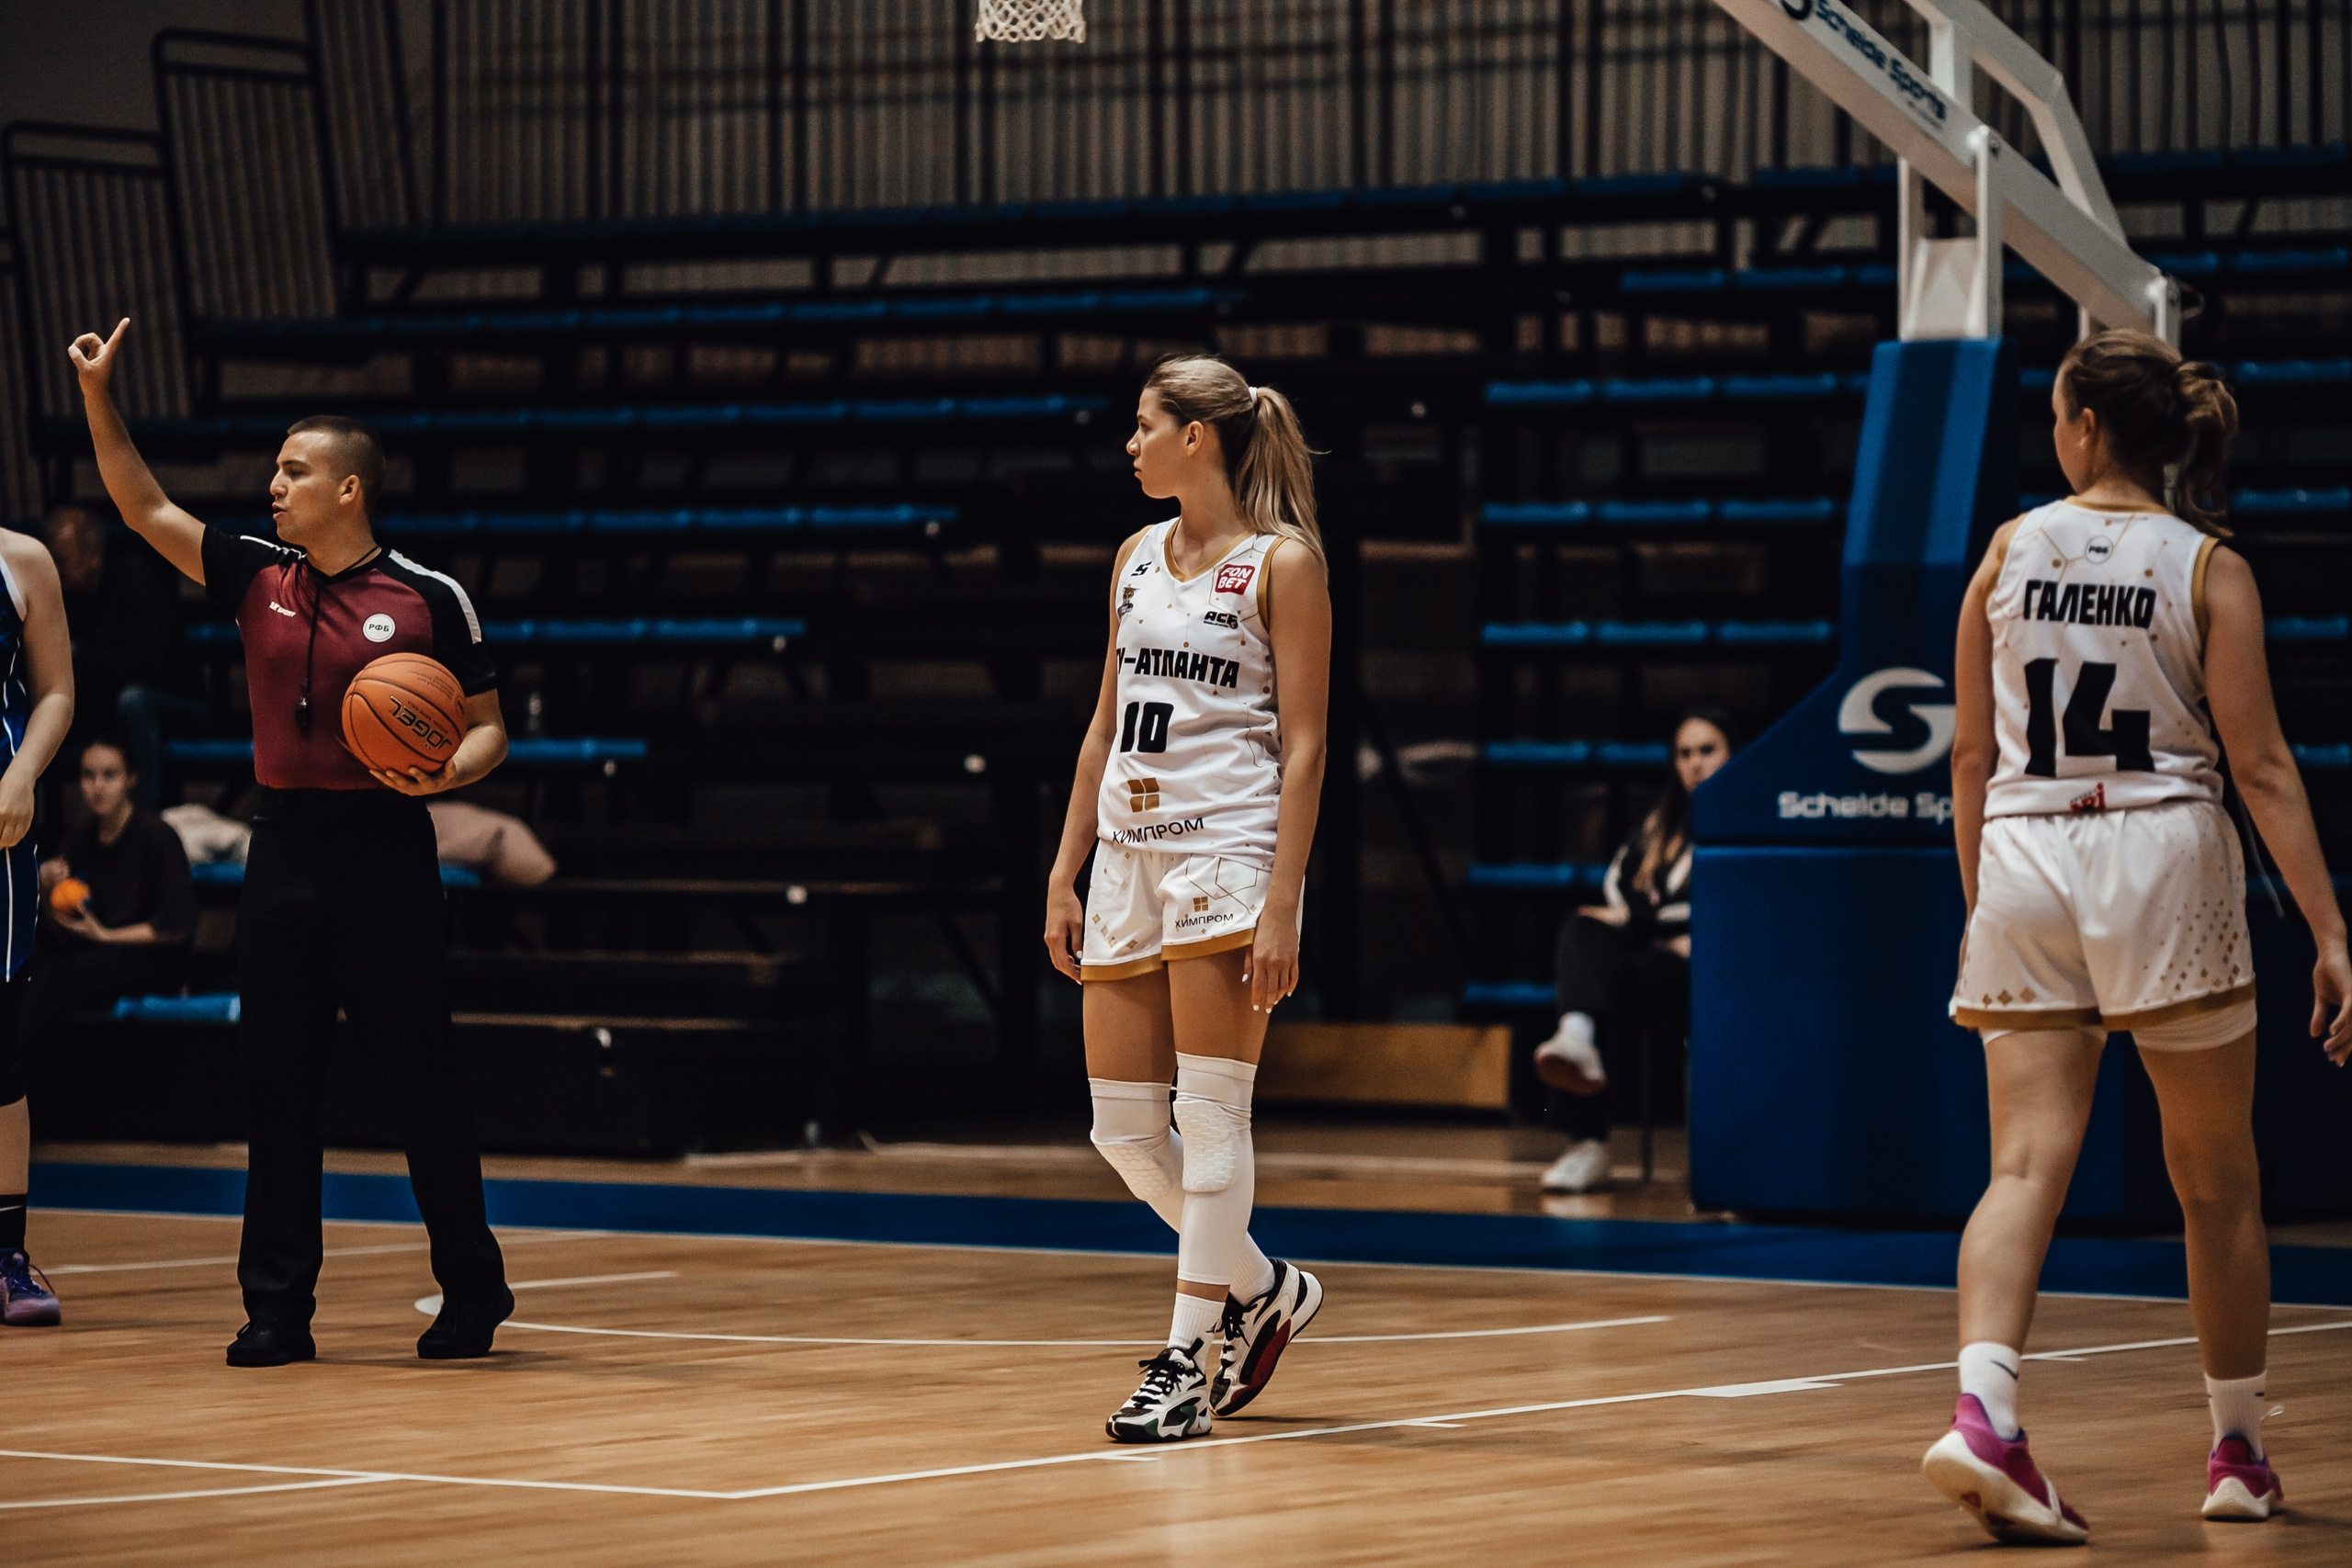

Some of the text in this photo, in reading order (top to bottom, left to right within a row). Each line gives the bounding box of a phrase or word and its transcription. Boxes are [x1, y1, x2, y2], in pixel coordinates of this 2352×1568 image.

[1217, 578, 1248, 590] BET
[1222, 567, 1252, 580] FON
[2023, 579, 2157, 630] ГАЛЕНКО
[368, 623, 390, 632] РФБ
[1116, 648, 1240, 688] У-АТЛАНТА
[390, 695, 452, 750] JÖGEL
[1119, 701, 1175, 753] 10
[2023, 658, 2156, 778] 14
[1112, 817, 1204, 844] ХИМПРОМ
[1174, 913, 1234, 929] ХИМПРОМ
